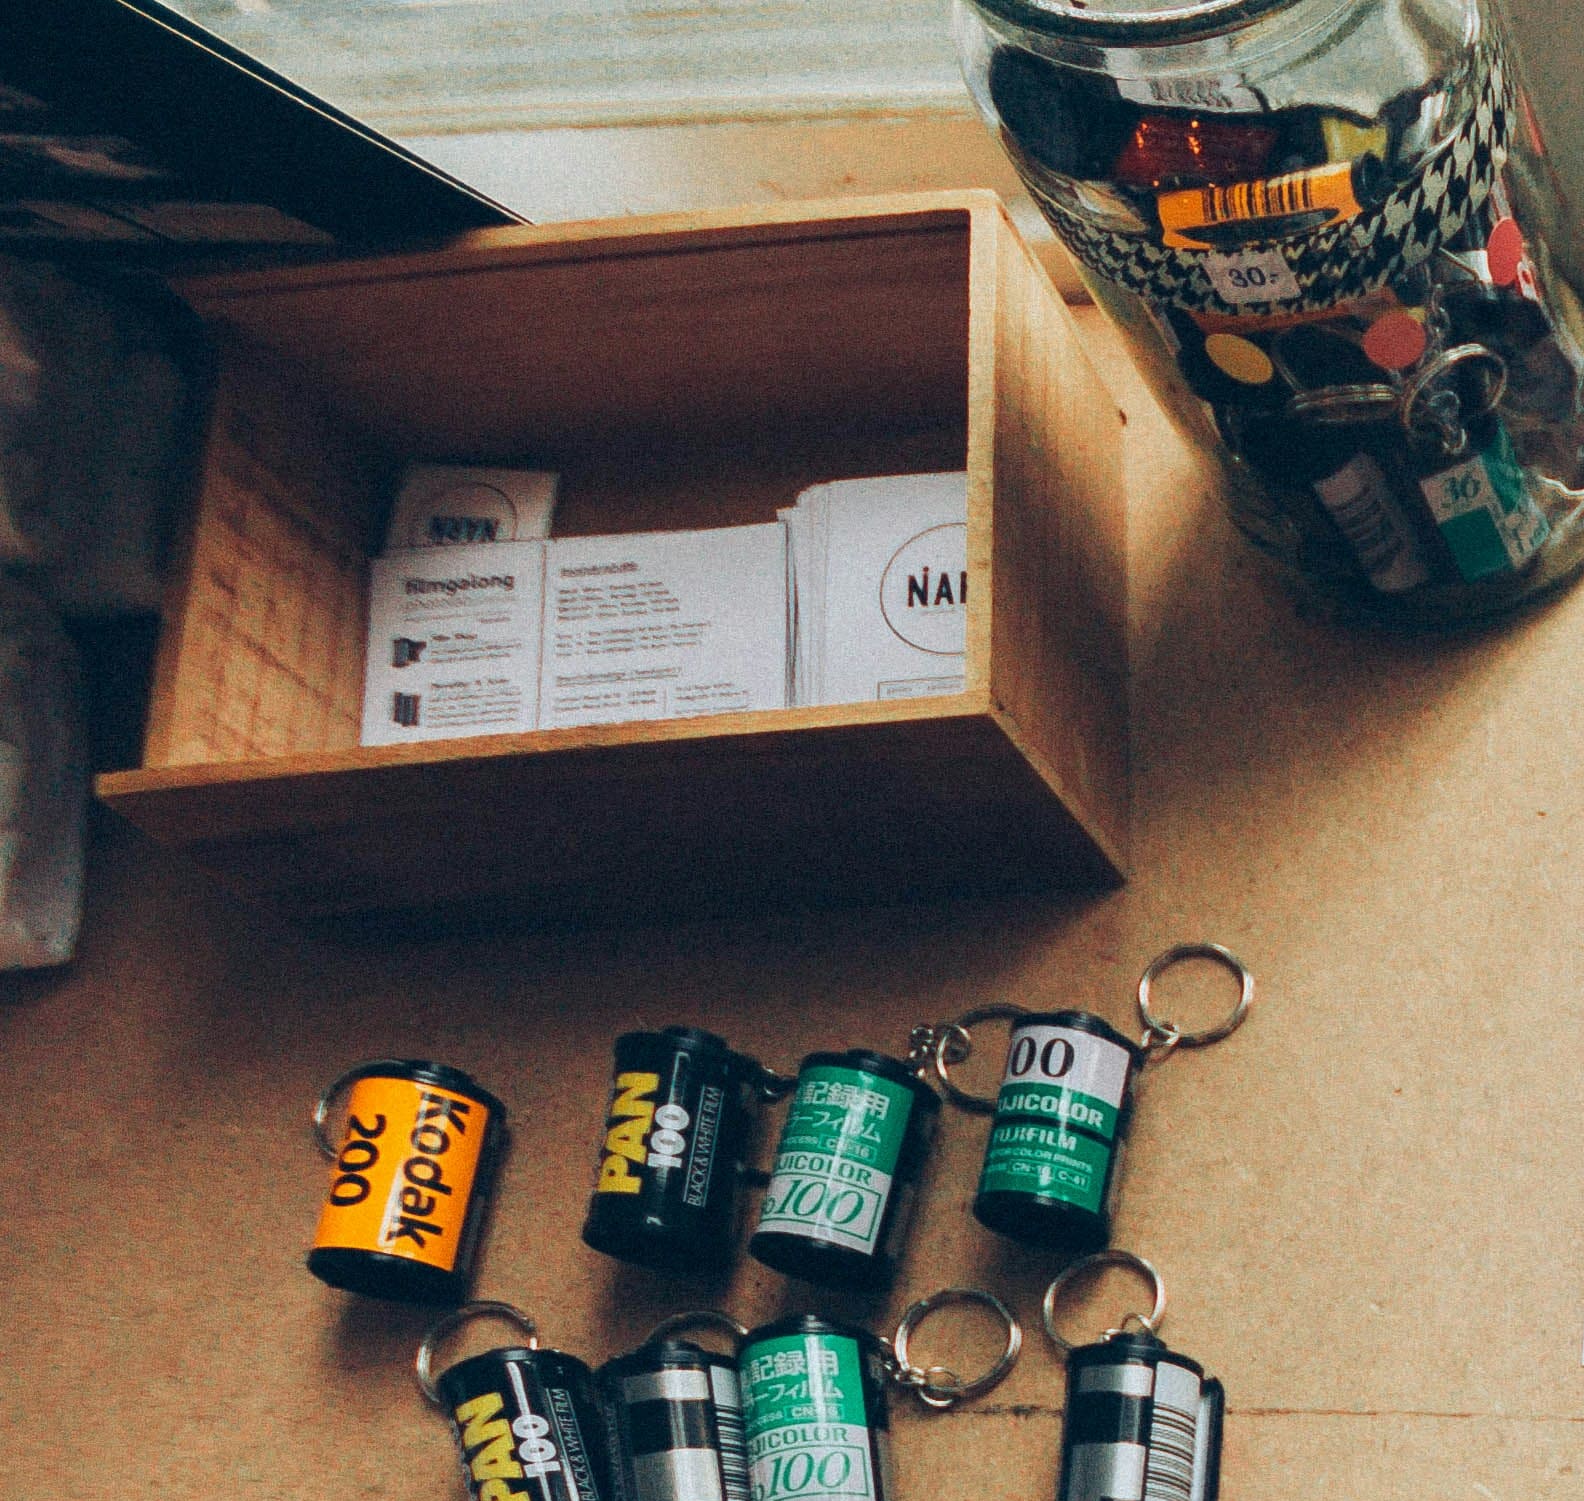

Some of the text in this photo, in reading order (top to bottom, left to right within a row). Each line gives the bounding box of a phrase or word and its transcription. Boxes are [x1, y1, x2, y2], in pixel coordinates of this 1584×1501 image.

[1011, 1036, 1075, 1078] 00
[797, 1081, 890, 1120] 記録用
[1000, 1093, 1104, 1129] UJICOLOR
[330, 1114, 387, 1206] 200
[598, 1071, 661, 1194] PAN
[647, 1104, 690, 1168] 100
[386, 1091, 471, 1248] Kodak
[774, 1179, 865, 1225] 100
[512, 1414, 561, 1478] 100
[767, 1451, 851, 1499] 100
